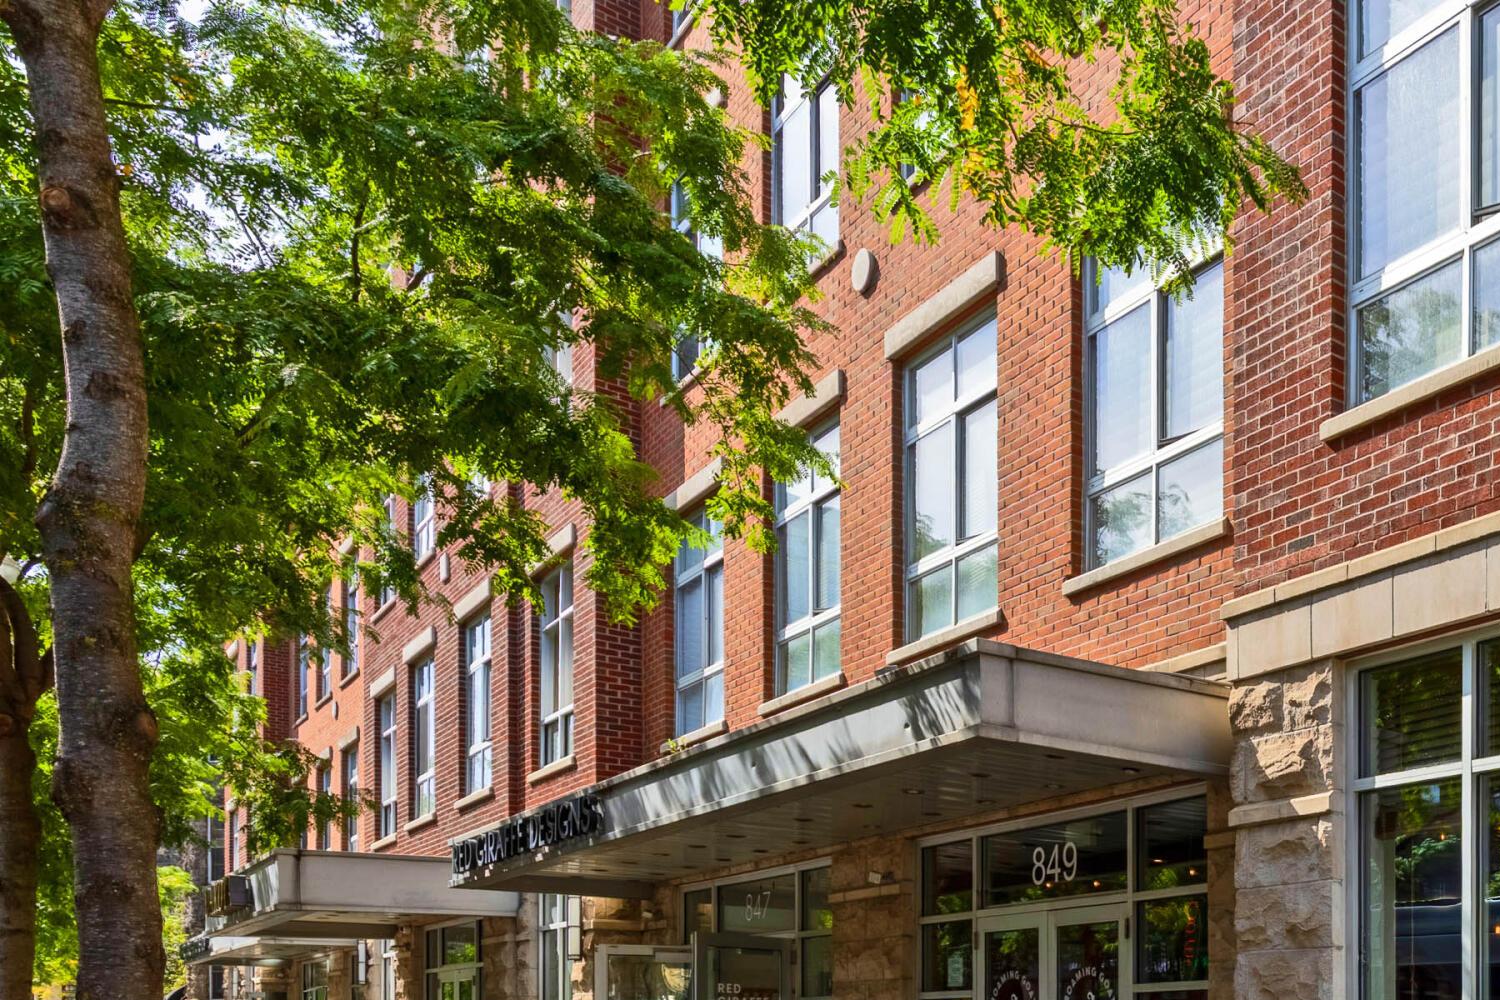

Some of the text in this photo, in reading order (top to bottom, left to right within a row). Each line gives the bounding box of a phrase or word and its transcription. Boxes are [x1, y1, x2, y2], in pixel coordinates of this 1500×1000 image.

[453, 795, 592, 873] RED GIRAFFE DESIGNS
[1032, 842, 1077, 885] 849
[744, 891, 771, 921] 847
[717, 983, 741, 994] RED
